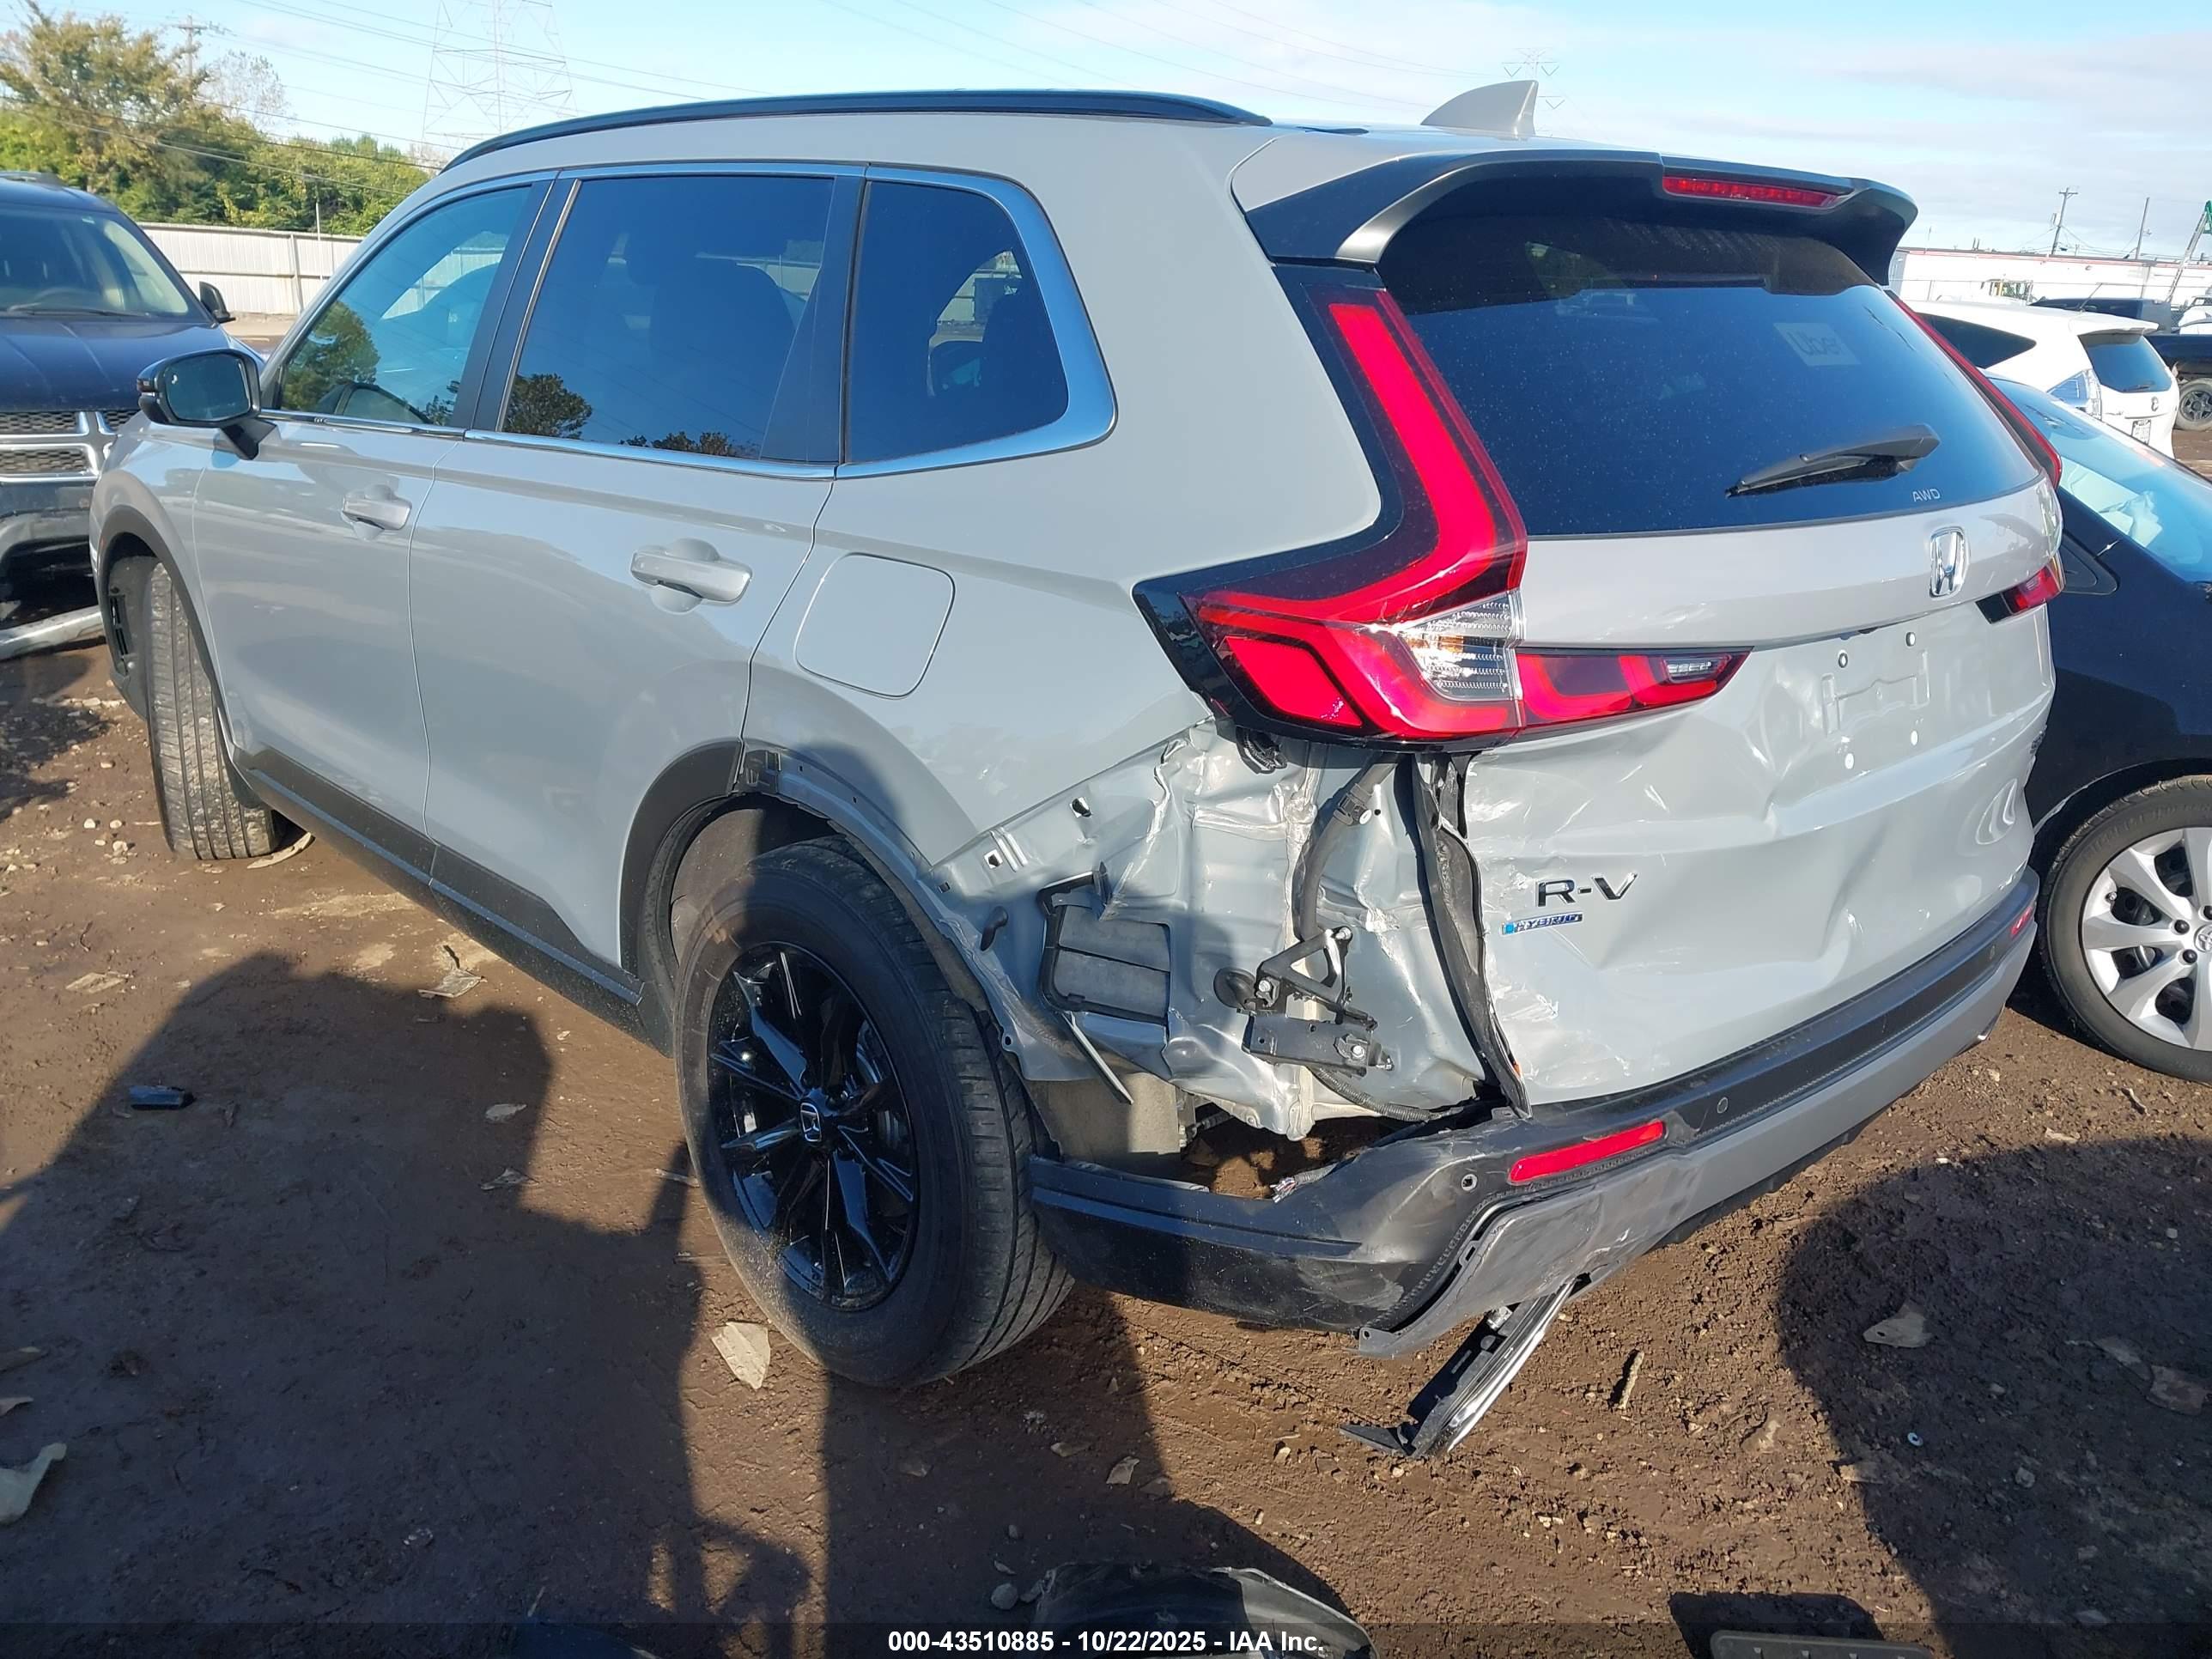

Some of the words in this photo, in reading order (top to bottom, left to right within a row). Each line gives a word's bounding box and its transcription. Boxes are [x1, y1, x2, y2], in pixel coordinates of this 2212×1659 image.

[1912, 488, 1941, 502] AWD
[1534, 872, 1638, 908] R-V
[1515, 913, 1580, 933] HYBRID
